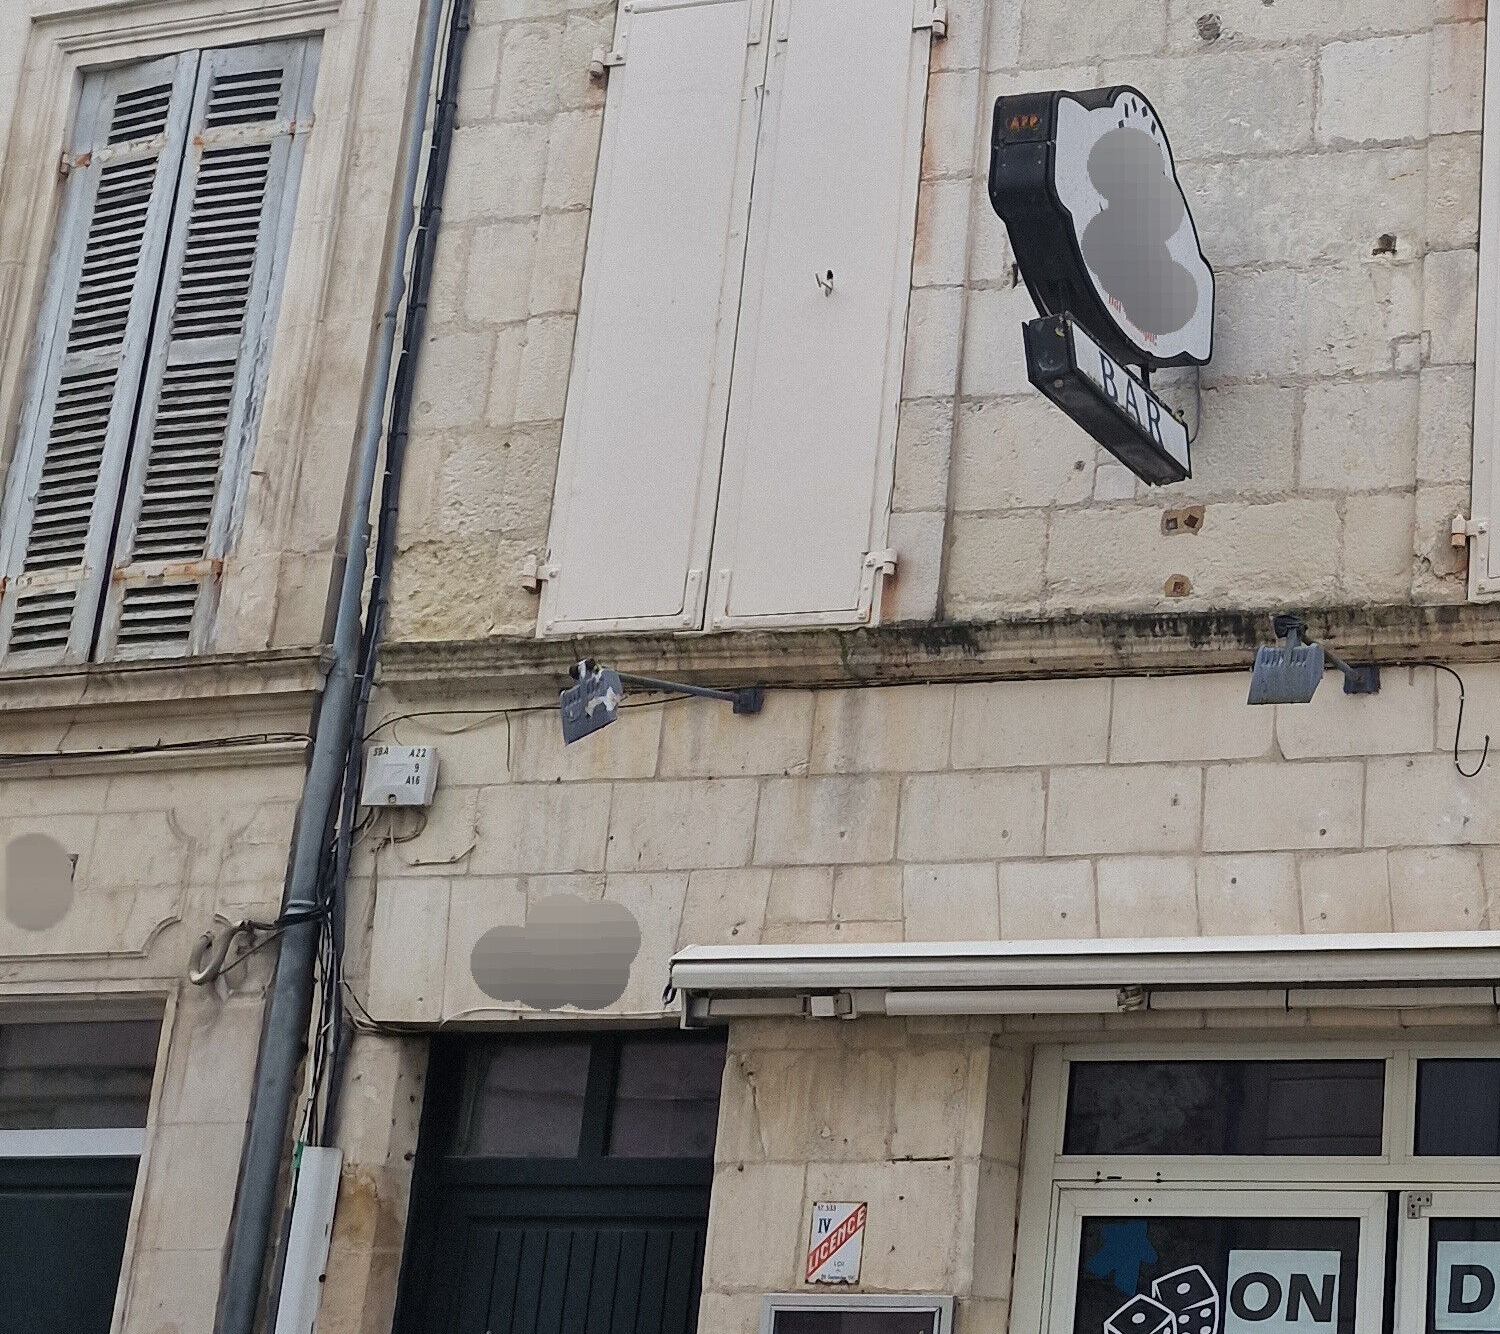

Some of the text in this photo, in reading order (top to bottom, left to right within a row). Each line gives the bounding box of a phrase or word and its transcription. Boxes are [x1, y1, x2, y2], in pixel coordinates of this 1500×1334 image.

[1099, 350, 1164, 450] BAR
[409, 748, 427, 758] A22
[414, 763, 420, 773] 9
[808, 1206, 866, 1274] LICENCE
[817, 1218, 832, 1234] IV
[1230, 1271, 1336, 1323] ON
